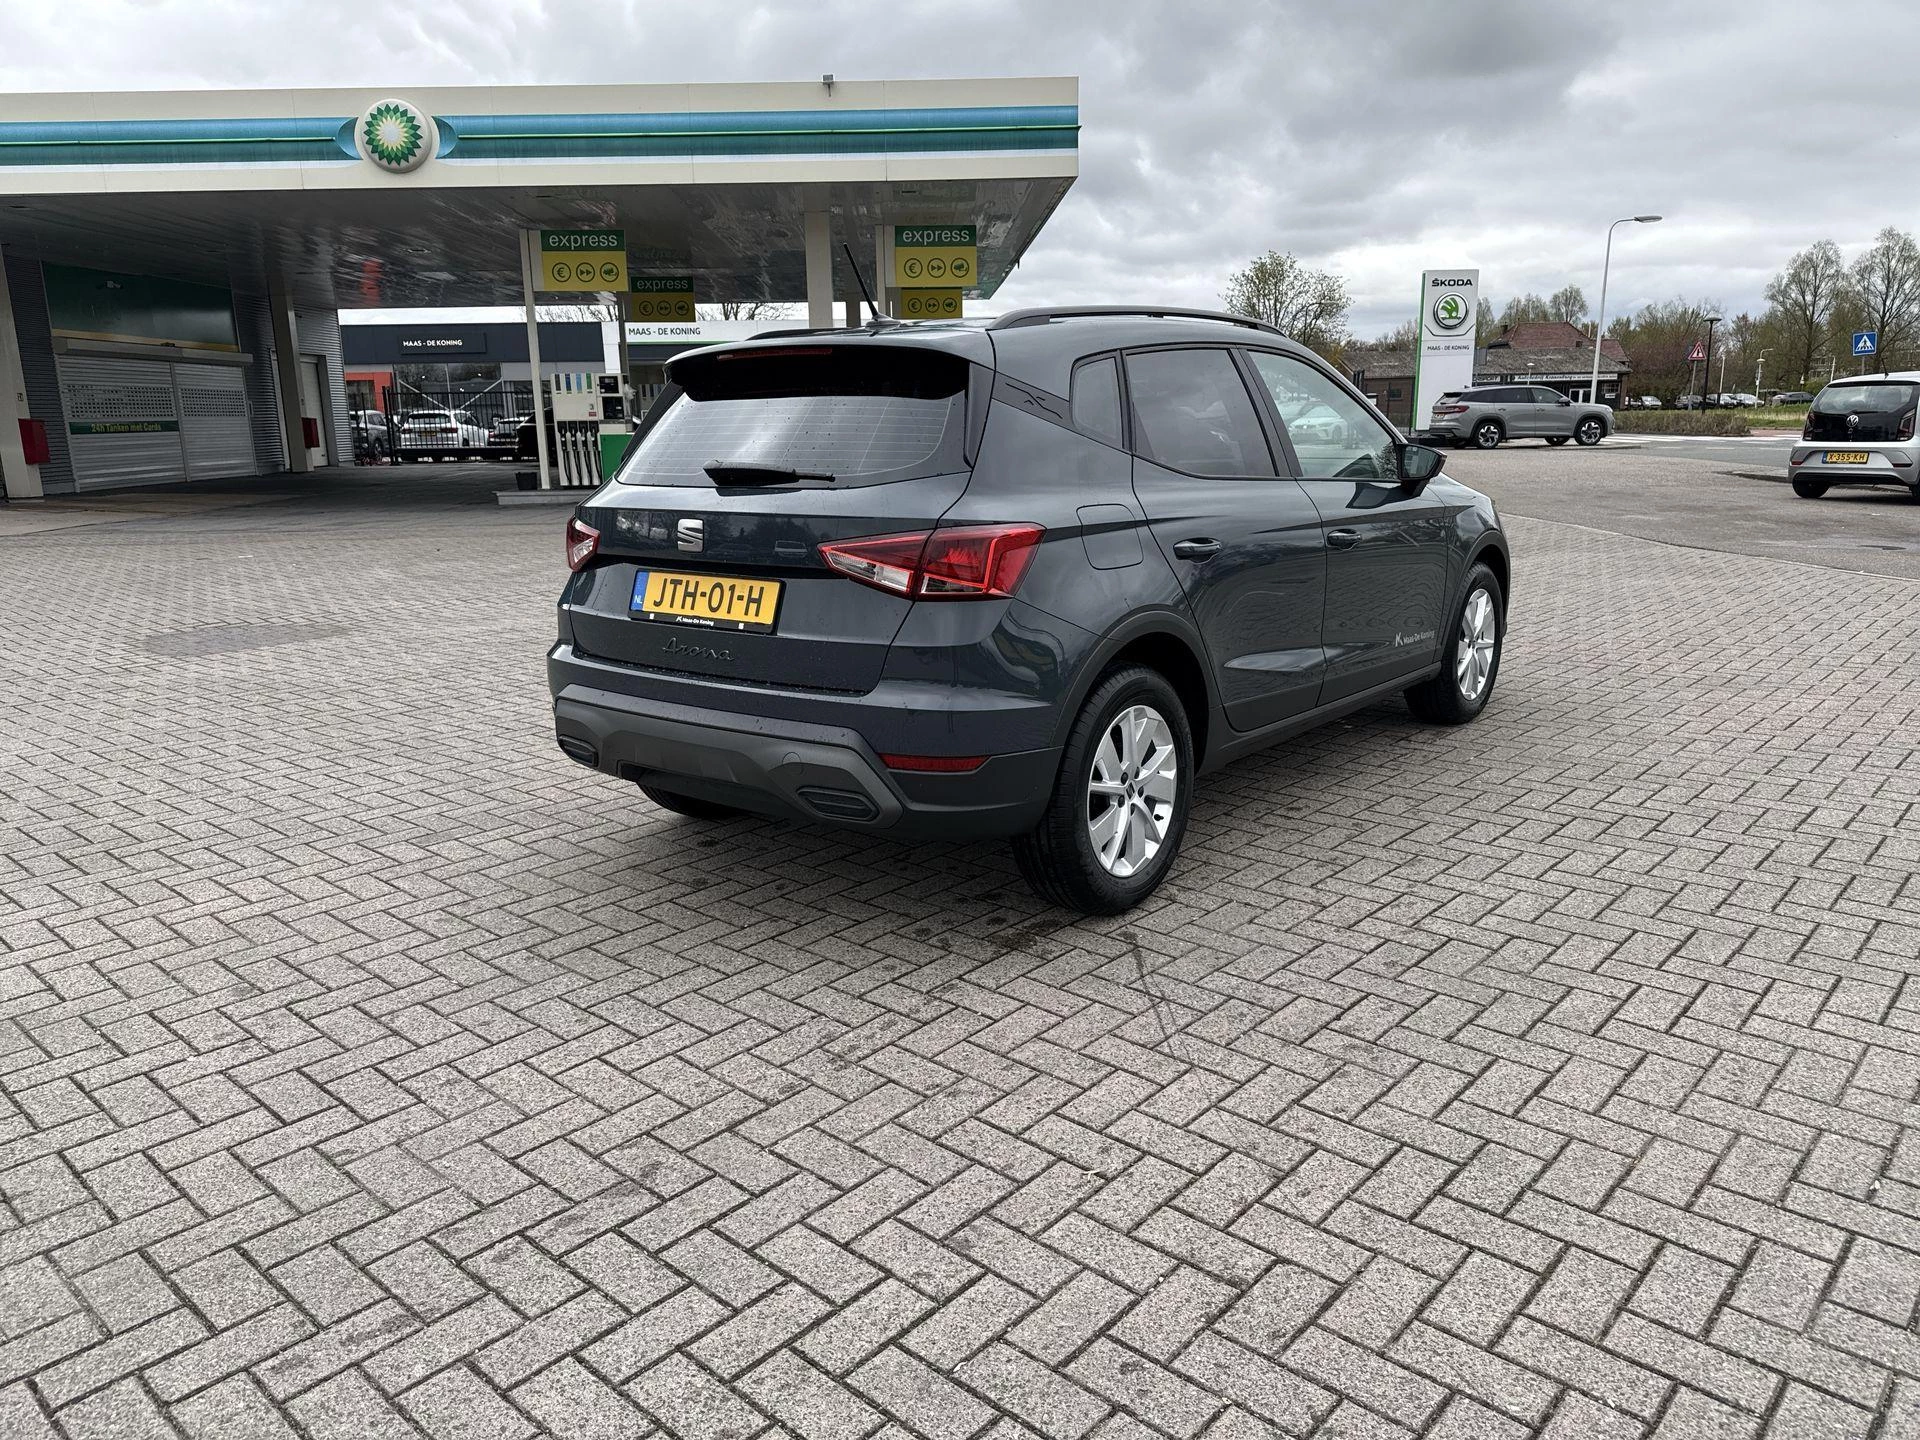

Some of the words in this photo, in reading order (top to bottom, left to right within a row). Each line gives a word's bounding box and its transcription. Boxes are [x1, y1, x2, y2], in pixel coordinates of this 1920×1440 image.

[549, 234, 618, 250] express
[902, 230, 970, 246] express
[636, 279, 688, 292] express
[1431, 277, 1473, 287] ŠKODA
[628, 327, 652, 336] MAAS
[657, 327, 669, 336] DE
[670, 327, 701, 336] KONING
[426, 339, 436, 347] DE
[91, 423, 105, 433] 24h
[105, 423, 129, 432] Tanken
[1828, 453, 1866, 461] X-355-KH
[633, 594, 643, 605] NL
[652, 577, 765, 617] JTH-01-H
[662, 637, 735, 662] Arona
